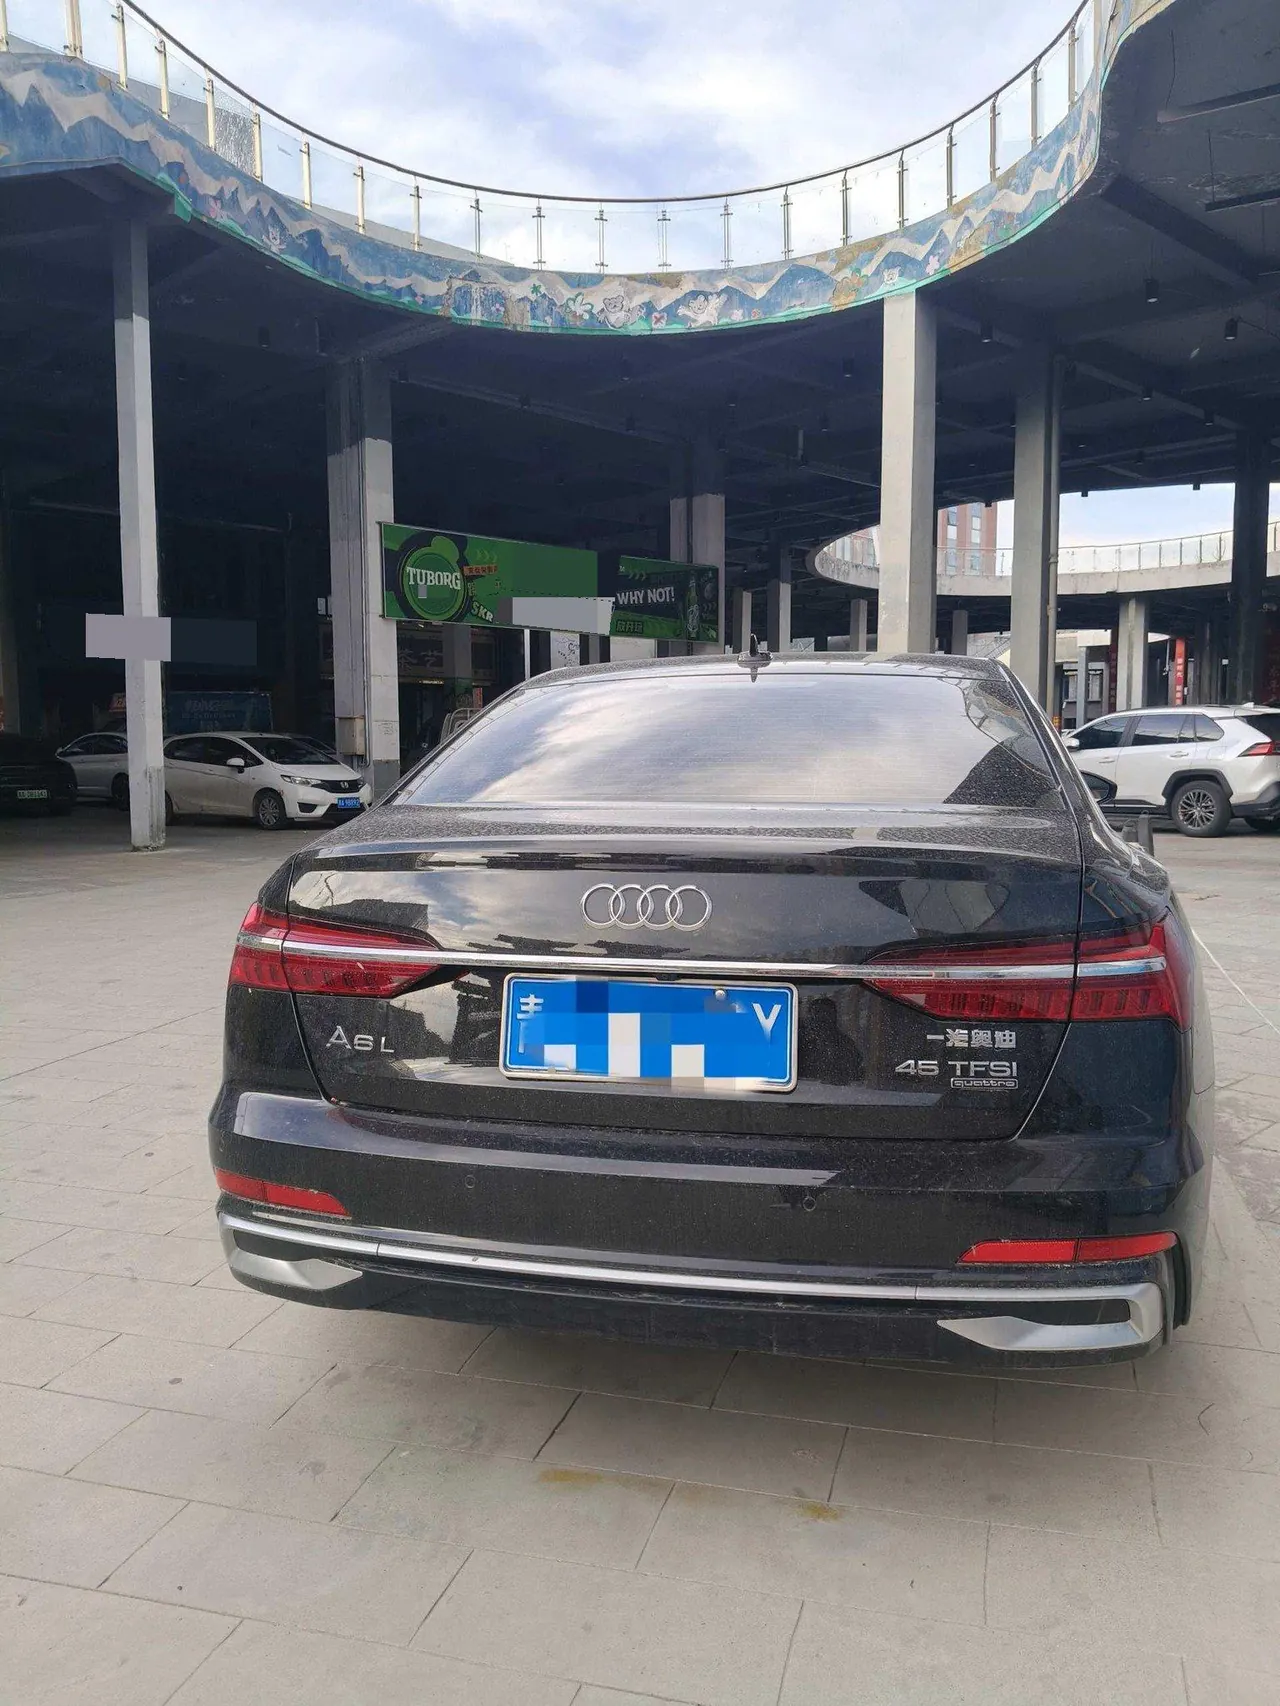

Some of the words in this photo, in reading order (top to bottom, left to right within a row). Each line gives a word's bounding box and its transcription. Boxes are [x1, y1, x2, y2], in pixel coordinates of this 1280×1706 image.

[406, 566, 462, 591] TUBORG
[616, 590, 644, 606] WHY
[647, 586, 676, 604] NOT!
[471, 601, 494, 624] SKR
[926, 1028, 1017, 1049] 一汽奥迪
[894, 1059, 940, 1076] 45
[948, 1061, 1018, 1077] TFSI
[953, 1079, 1016, 1089] quattro
